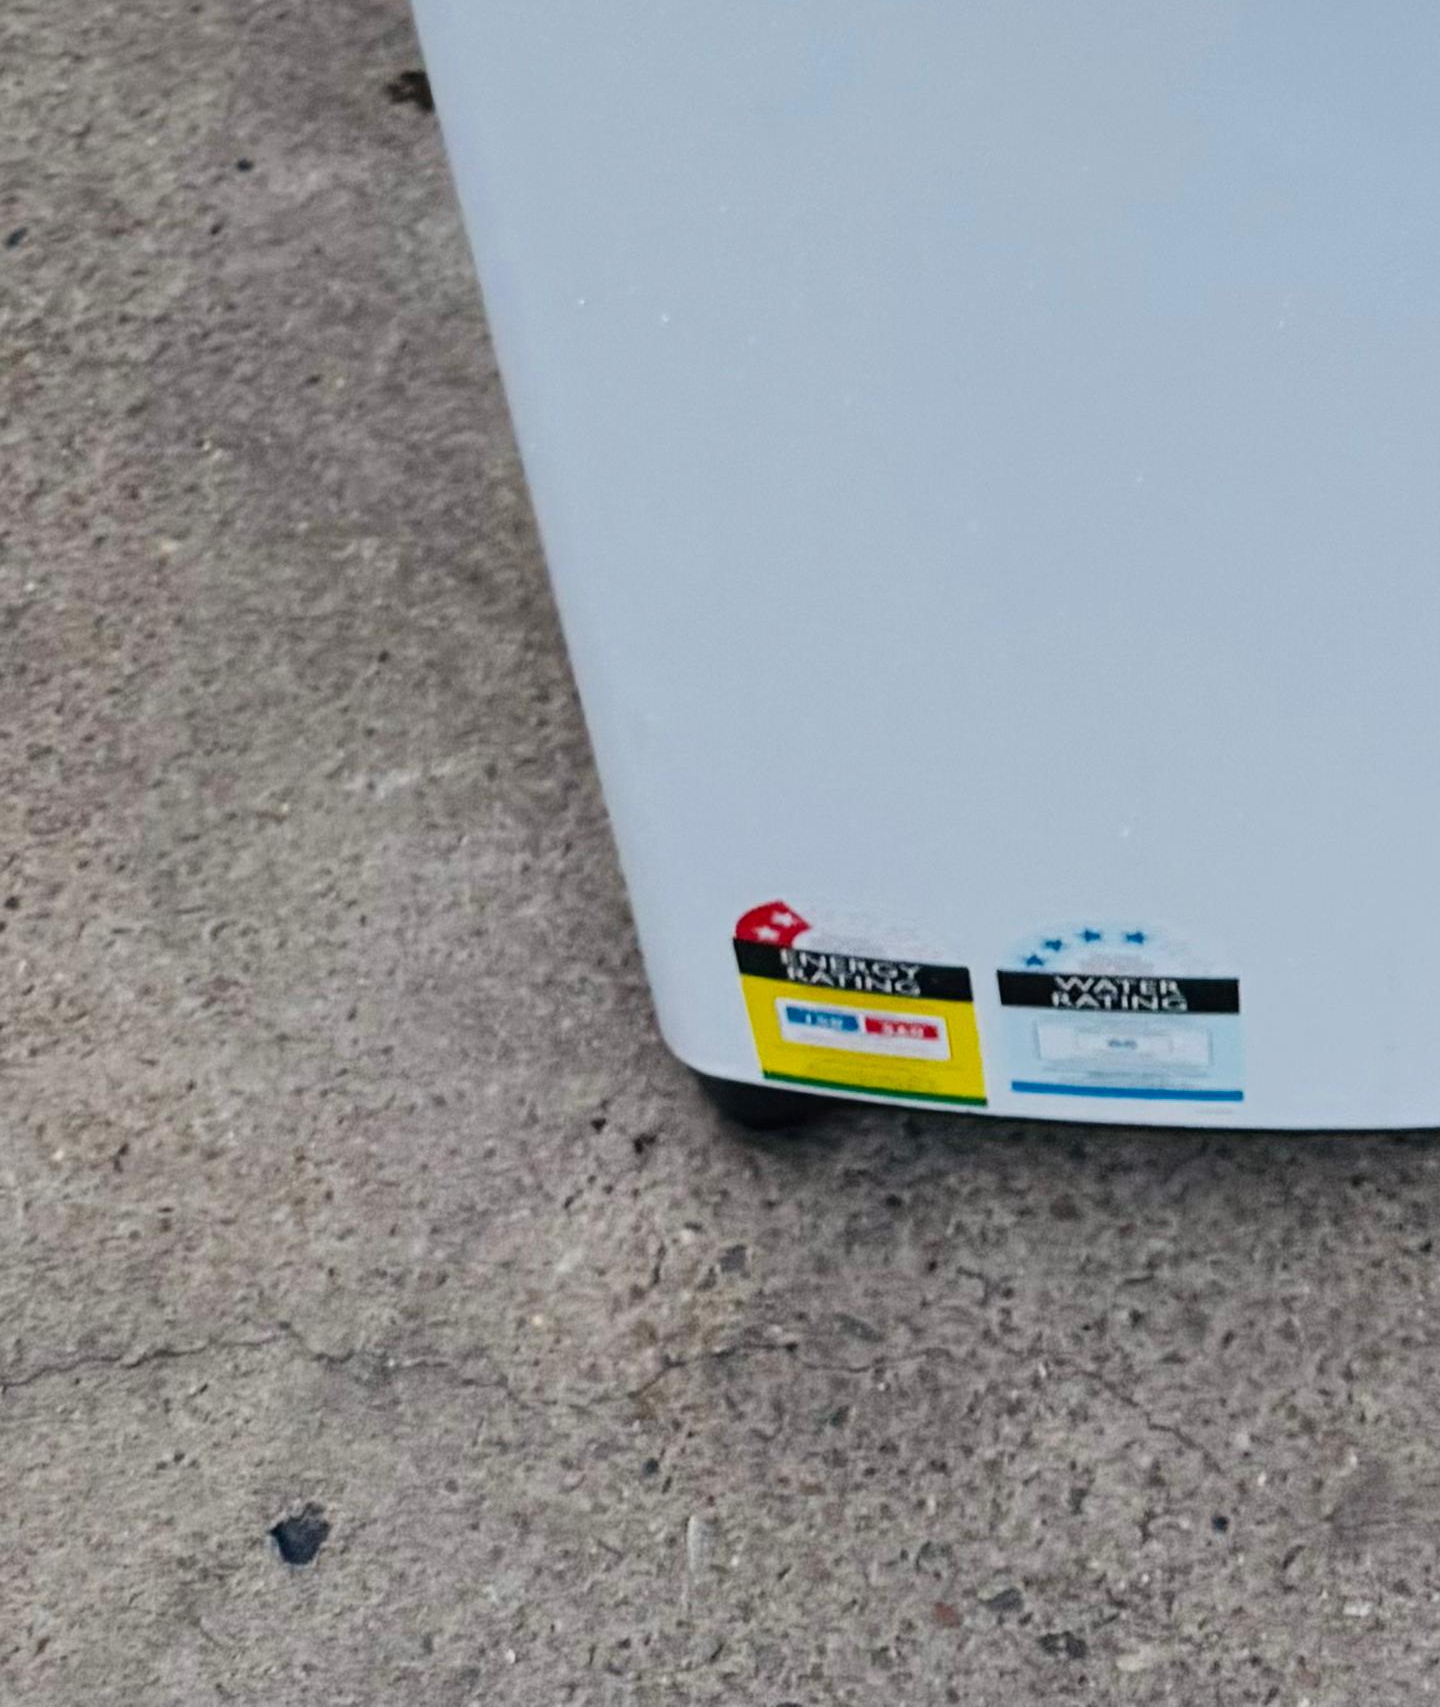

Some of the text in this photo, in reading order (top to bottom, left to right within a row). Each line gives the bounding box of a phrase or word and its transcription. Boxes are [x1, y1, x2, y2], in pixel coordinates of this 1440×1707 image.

[780, 948, 920, 981] ENERGY
[787, 965, 921, 997] RATING
[1054, 975, 1182, 996] WATER
[1051, 990, 1188, 1011] RATING
